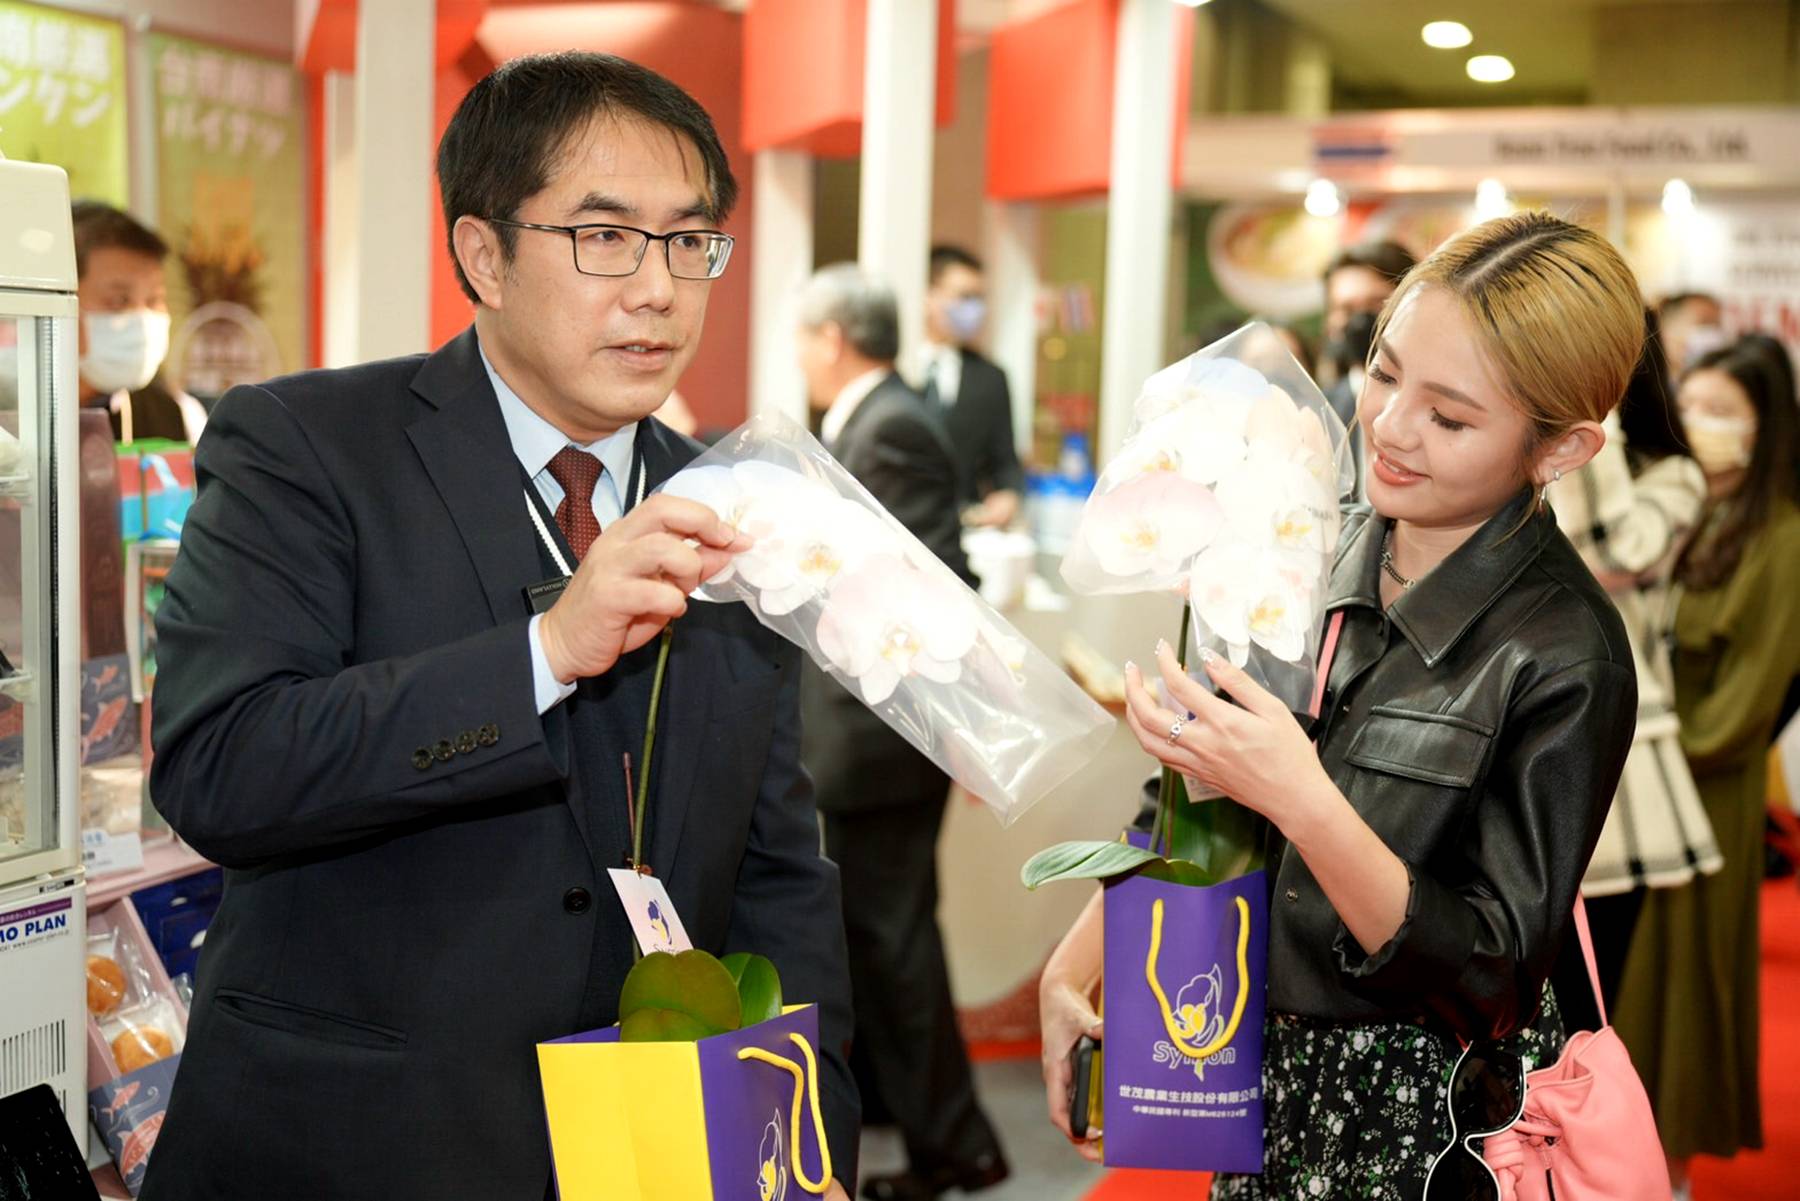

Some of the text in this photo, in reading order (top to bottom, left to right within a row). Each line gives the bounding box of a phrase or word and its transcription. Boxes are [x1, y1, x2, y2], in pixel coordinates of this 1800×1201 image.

[25, 914, 66, 937] PLAN
[1119, 1085, 1258, 1105] 世茂農業生技股份有限公司
